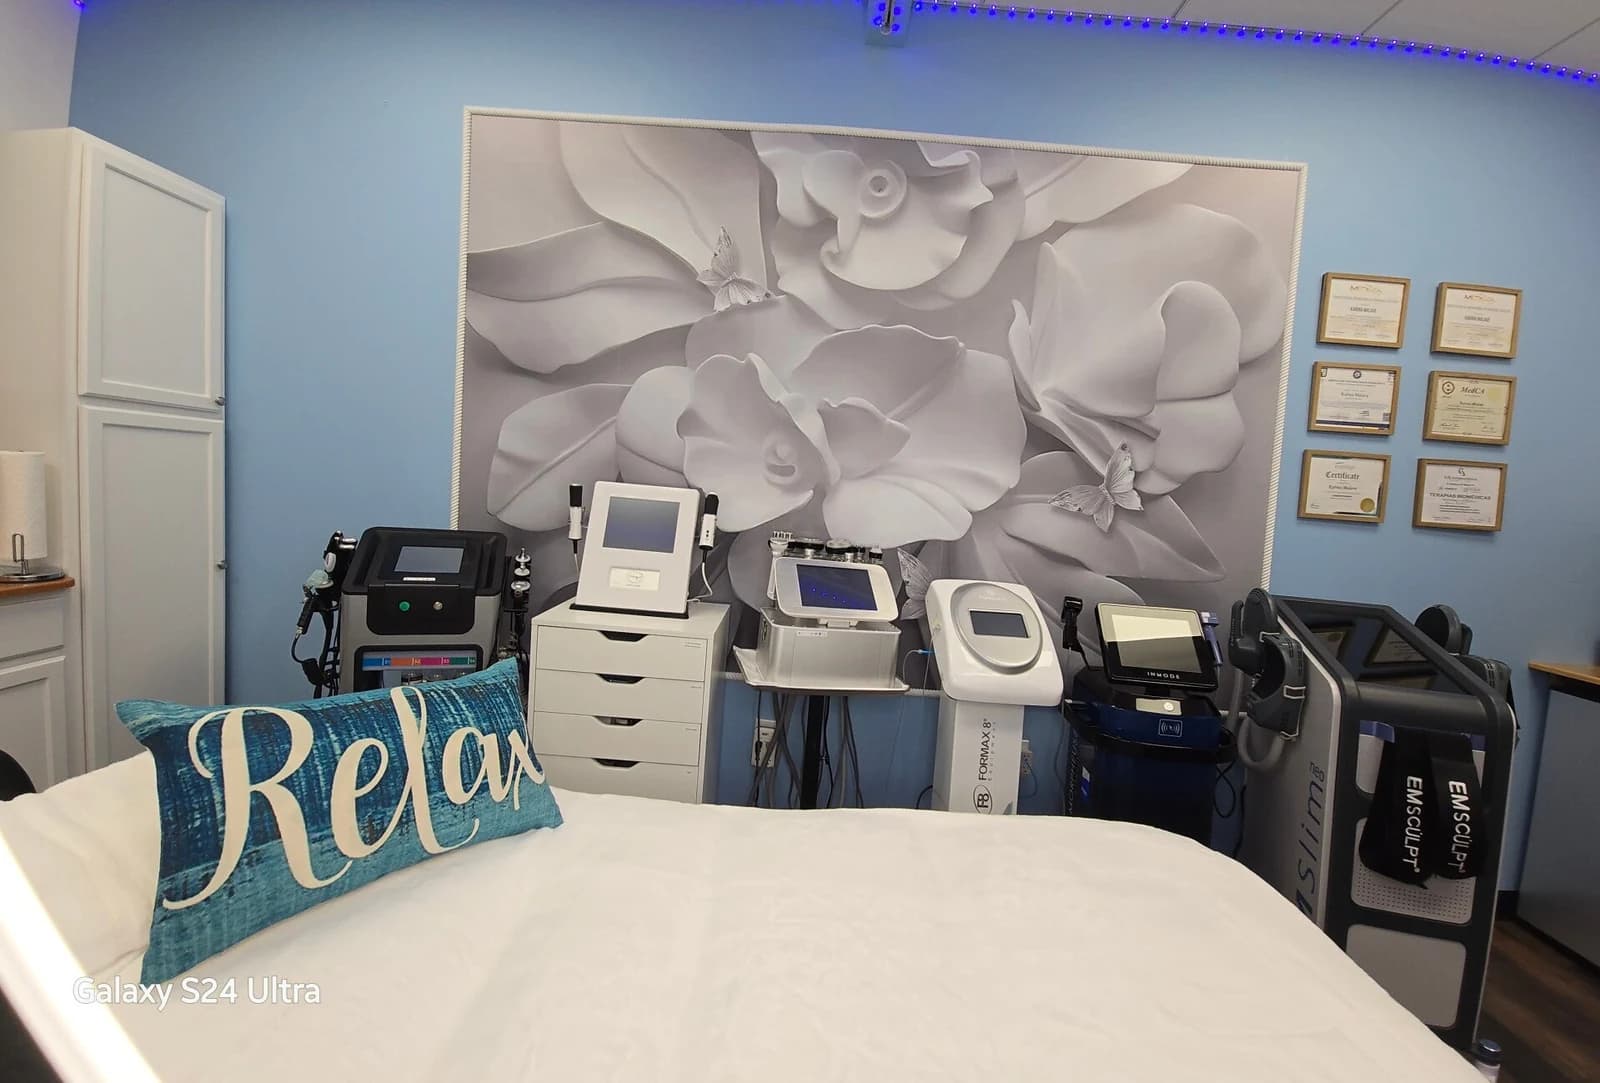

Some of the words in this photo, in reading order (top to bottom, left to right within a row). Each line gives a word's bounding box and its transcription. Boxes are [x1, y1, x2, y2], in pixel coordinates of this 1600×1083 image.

[1325, 471, 1360, 480] Certificate
[1147, 671, 1180, 680] INMODE
[978, 731, 991, 781] FORMAX
[162, 685, 545, 910] Relax
